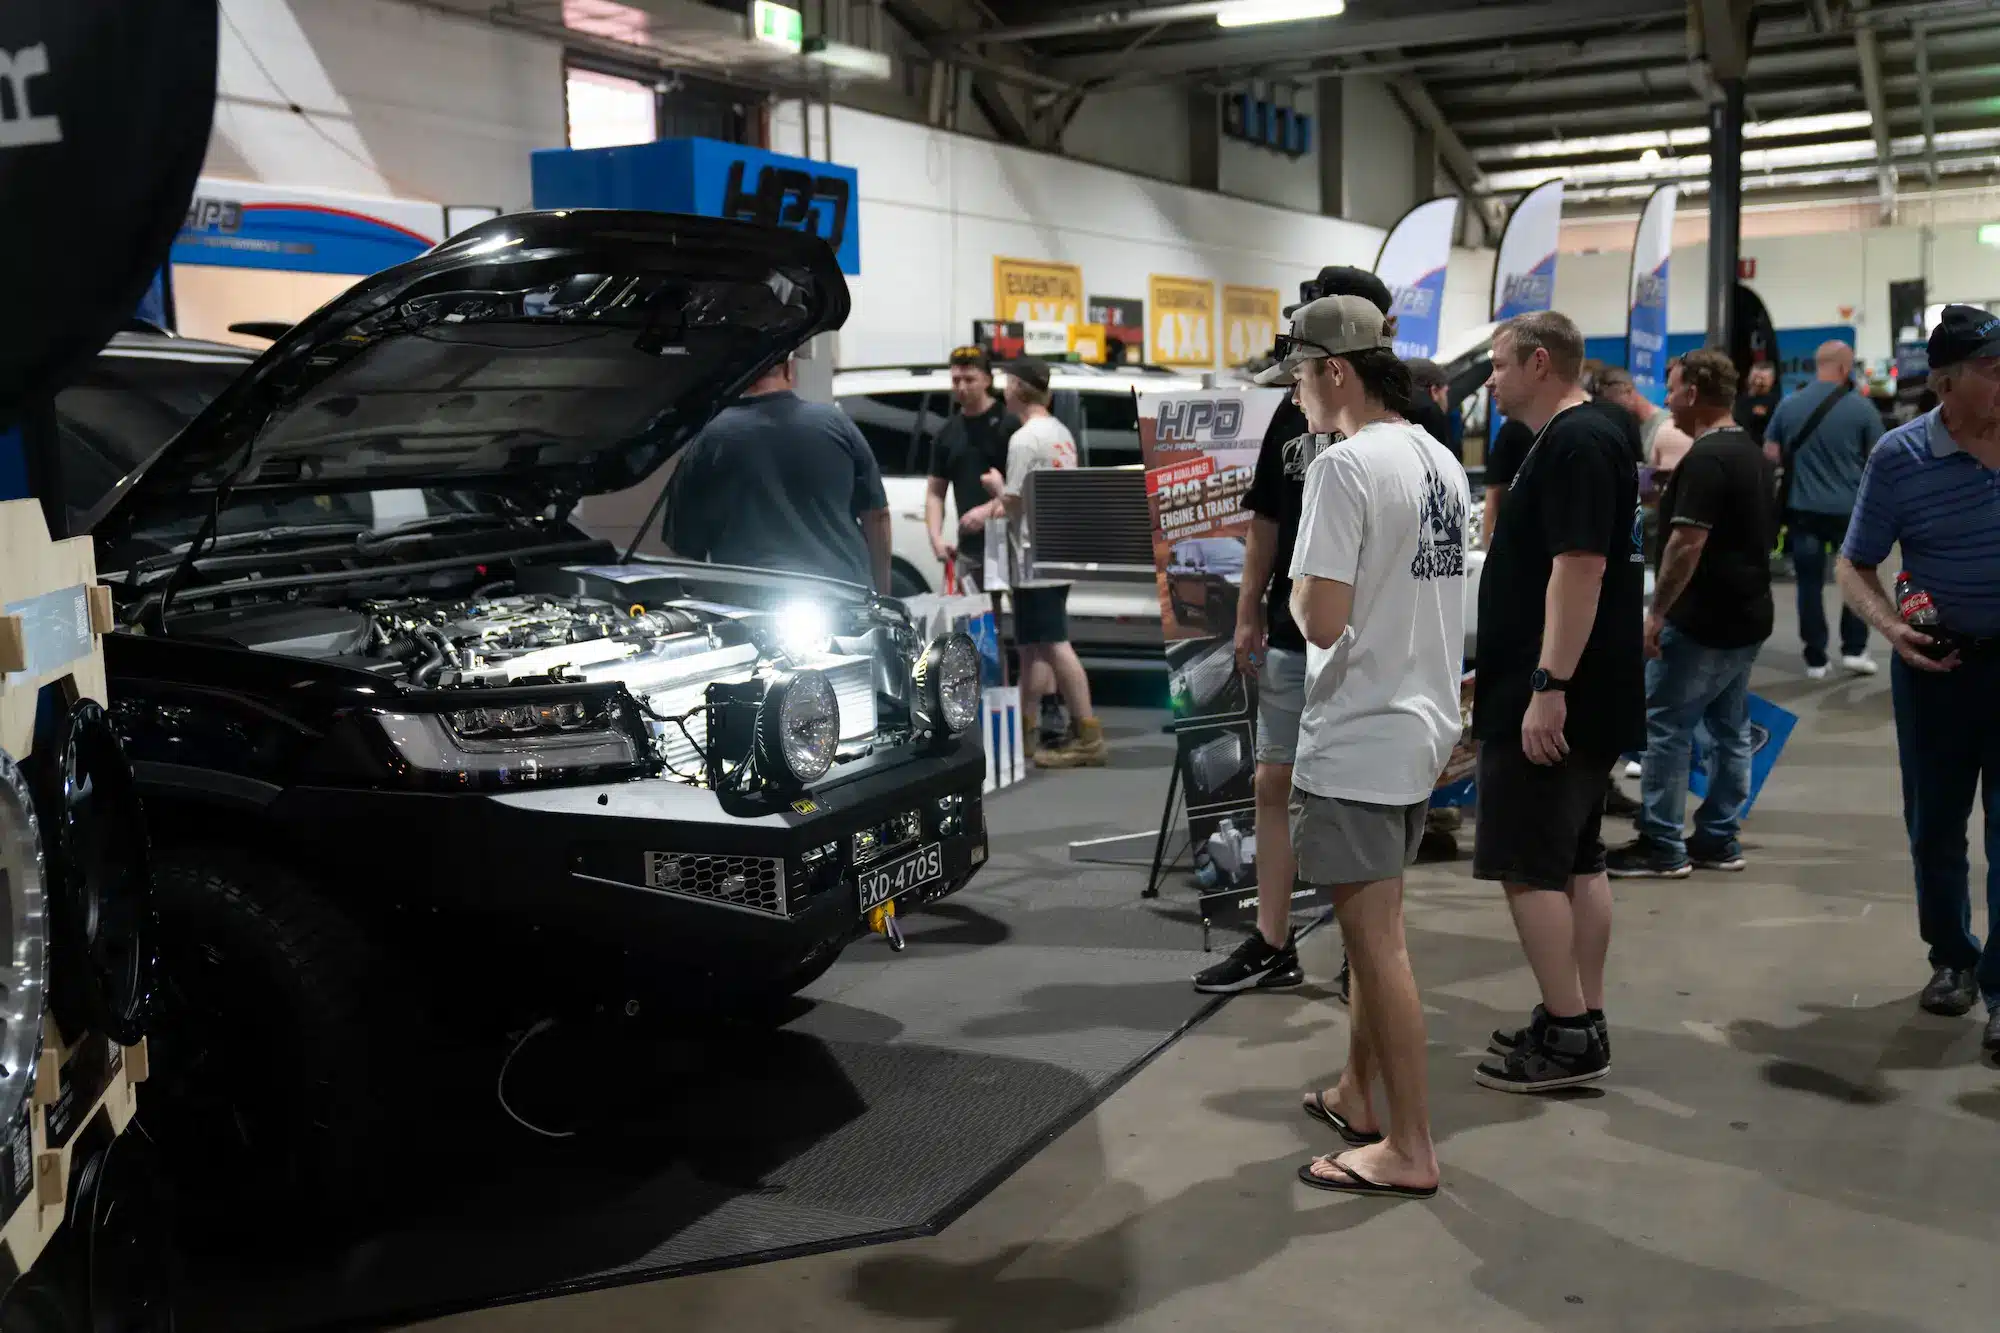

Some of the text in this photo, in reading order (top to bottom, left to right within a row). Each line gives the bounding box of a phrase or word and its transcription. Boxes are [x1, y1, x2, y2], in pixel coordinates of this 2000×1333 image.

[1158, 312, 1208, 361] 4X4
[1156, 399, 1244, 441] HPD
[1156, 472, 1173, 487] NOW
[1157, 479, 1202, 512] 300
[1160, 506, 1195, 530] ENGINE
[1196, 504, 1206, 520] &
[1205, 496, 1236, 519] TRANS
